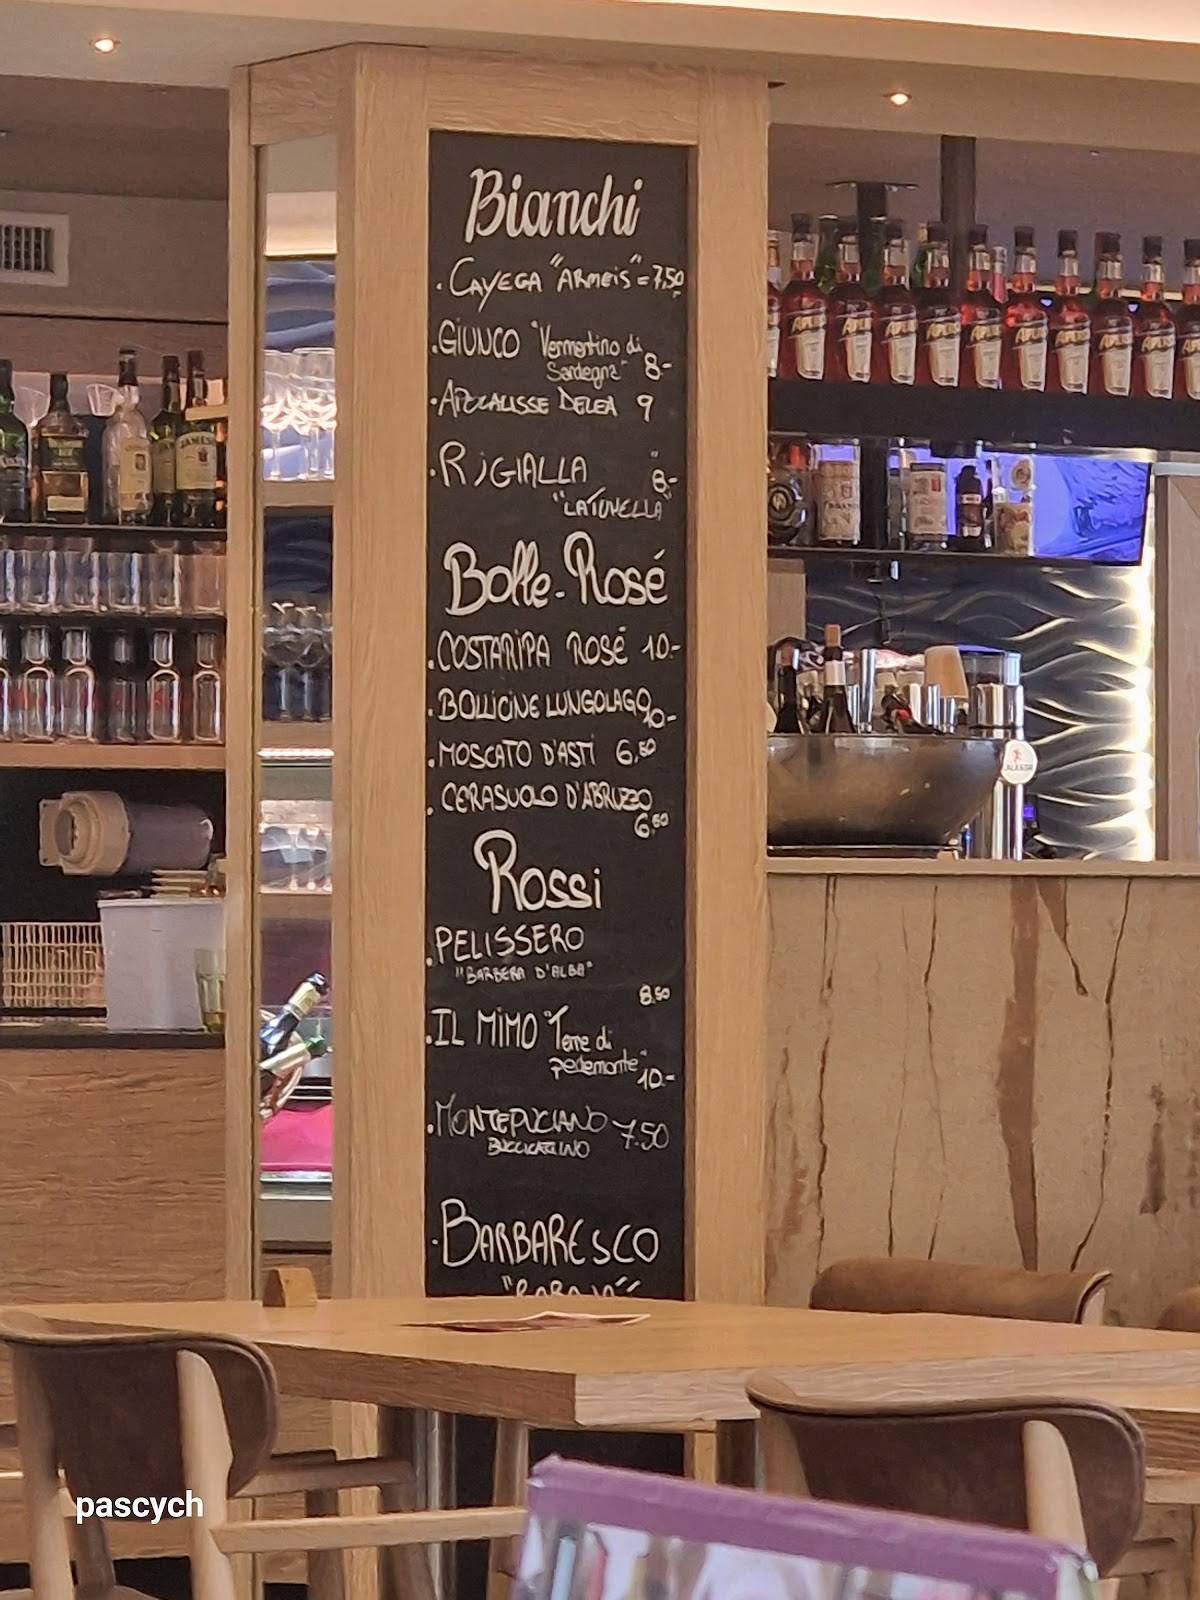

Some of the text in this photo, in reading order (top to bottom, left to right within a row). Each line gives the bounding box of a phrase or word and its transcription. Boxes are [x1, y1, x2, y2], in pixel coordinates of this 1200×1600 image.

[465, 168, 643, 243] Bianchi
[438, 318, 520, 358] GIUNCO
[557, 386, 618, 416] DELEA
[637, 394, 653, 422] 9
[437, 630, 550, 671] COSTARIPA
[545, 687, 652, 719] LUNGOLAGO
[438, 739, 532, 770] MOSCATO
[441, 781, 559, 813] CERASUOLO
[473, 829, 602, 914] Rossi
[434, 922, 585, 965] PELISSERO
[430, 1008, 465, 1047] IL
[476, 1006, 539, 1050] MIMO
[440, 1197, 660, 1269] BARBARESCO
